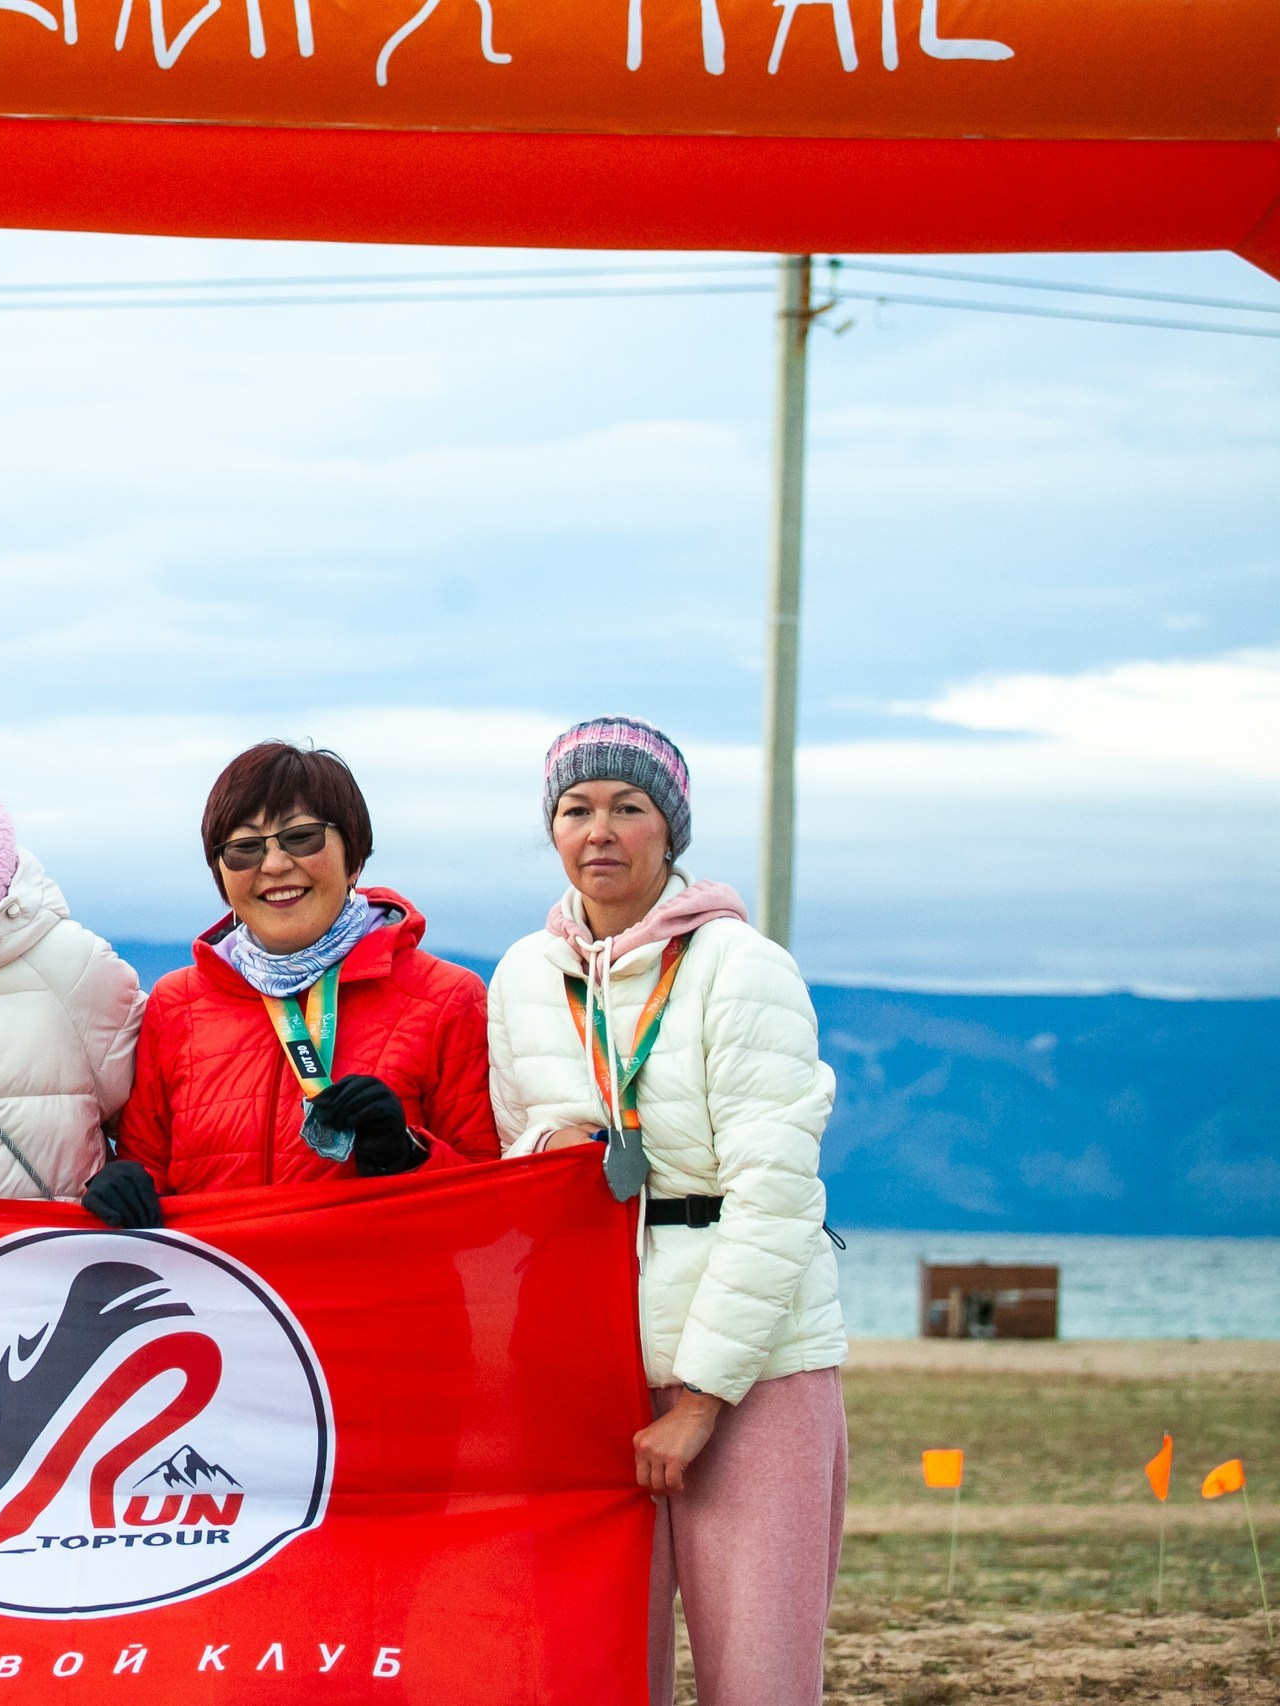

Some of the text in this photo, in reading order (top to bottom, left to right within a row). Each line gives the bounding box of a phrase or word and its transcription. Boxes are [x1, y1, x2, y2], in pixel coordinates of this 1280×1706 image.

[297, 1045, 310, 1056] 30
[301, 1056, 317, 1073] OUT
[35, 1528, 230, 1551] TOPTOUR
[197, 1642, 402, 1678] КЛУБ
